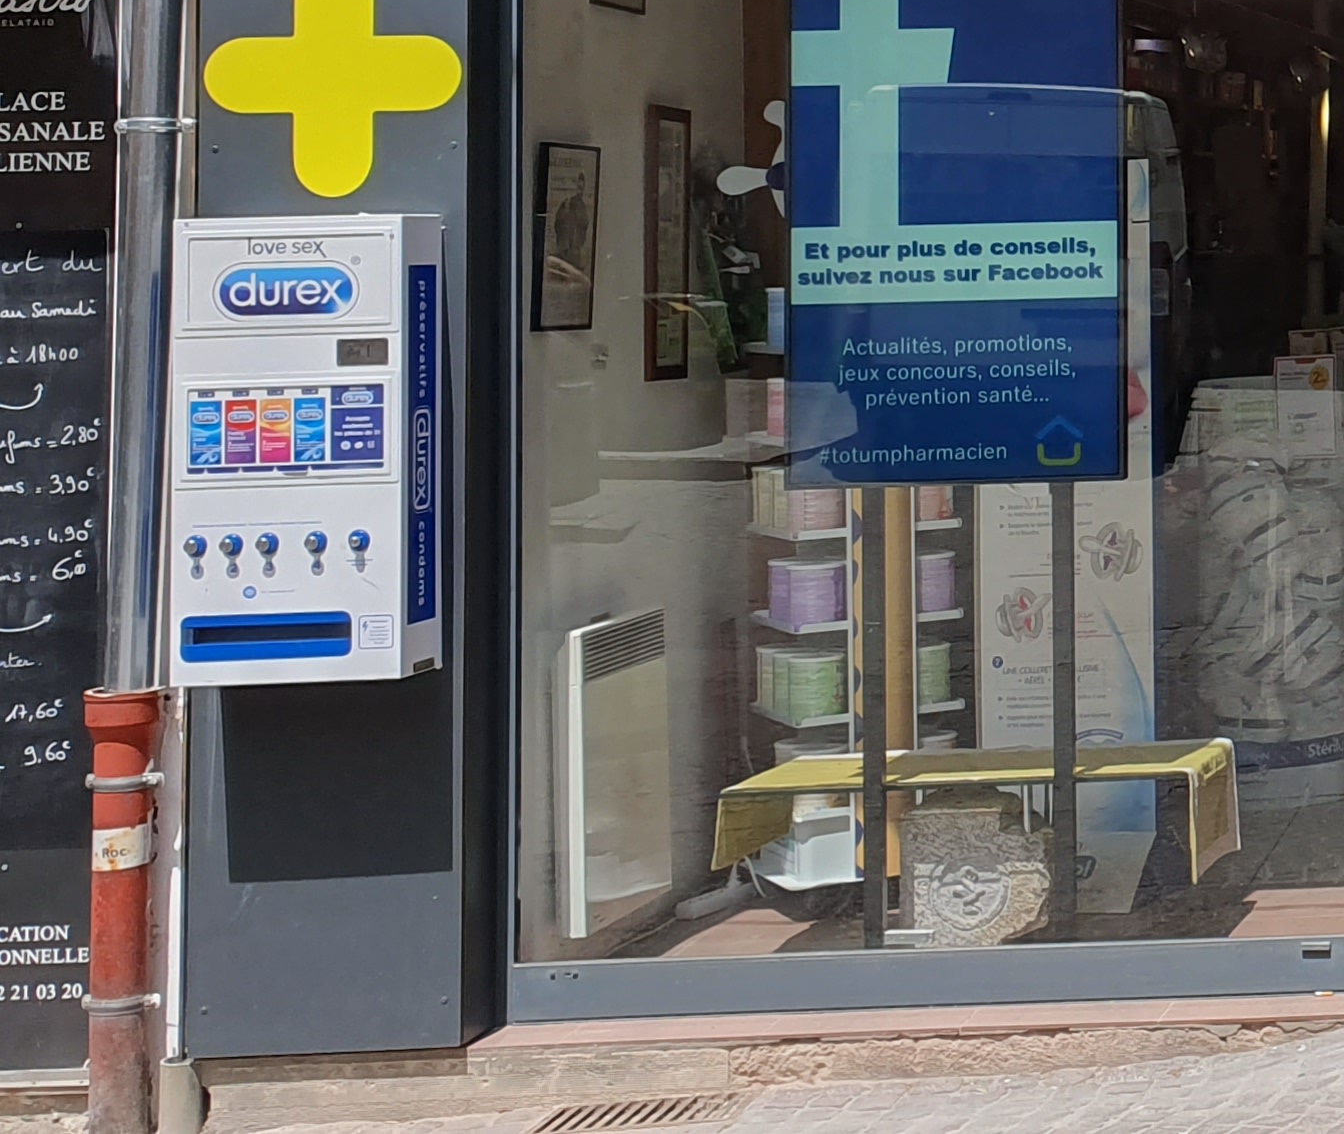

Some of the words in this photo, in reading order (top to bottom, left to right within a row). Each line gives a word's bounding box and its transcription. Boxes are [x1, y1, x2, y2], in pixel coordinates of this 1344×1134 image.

[247, 238, 287, 256] love
[291, 240, 328, 259] sex
[804, 242, 830, 260] Et
[837, 241, 890, 263] pour
[897, 240, 947, 262] plus
[953, 239, 983, 257] de
[990, 236, 1097, 257] conseils,
[797, 267, 873, 286] suivez
[879, 268, 936, 285] nous
[943, 266, 982, 283] sur
[987, 262, 1103, 283] Facebook
[228, 272, 344, 307] durex
[842, 336, 948, 358] Actualités,
[954, 334, 1073, 358] promotions,
[837, 365, 880, 387] jeux
[886, 364, 983, 383] concours,
[989, 359, 1077, 380] conseils,
[865, 388, 971, 410] prévention
[819, 443, 1008, 467] #totumpharmacien
[417, 521, 426, 606] condoms
[10, 984, 30, 1001] 21
[35, 983, 57, 1000] 03
[61, 982, 83, 1000] 20
